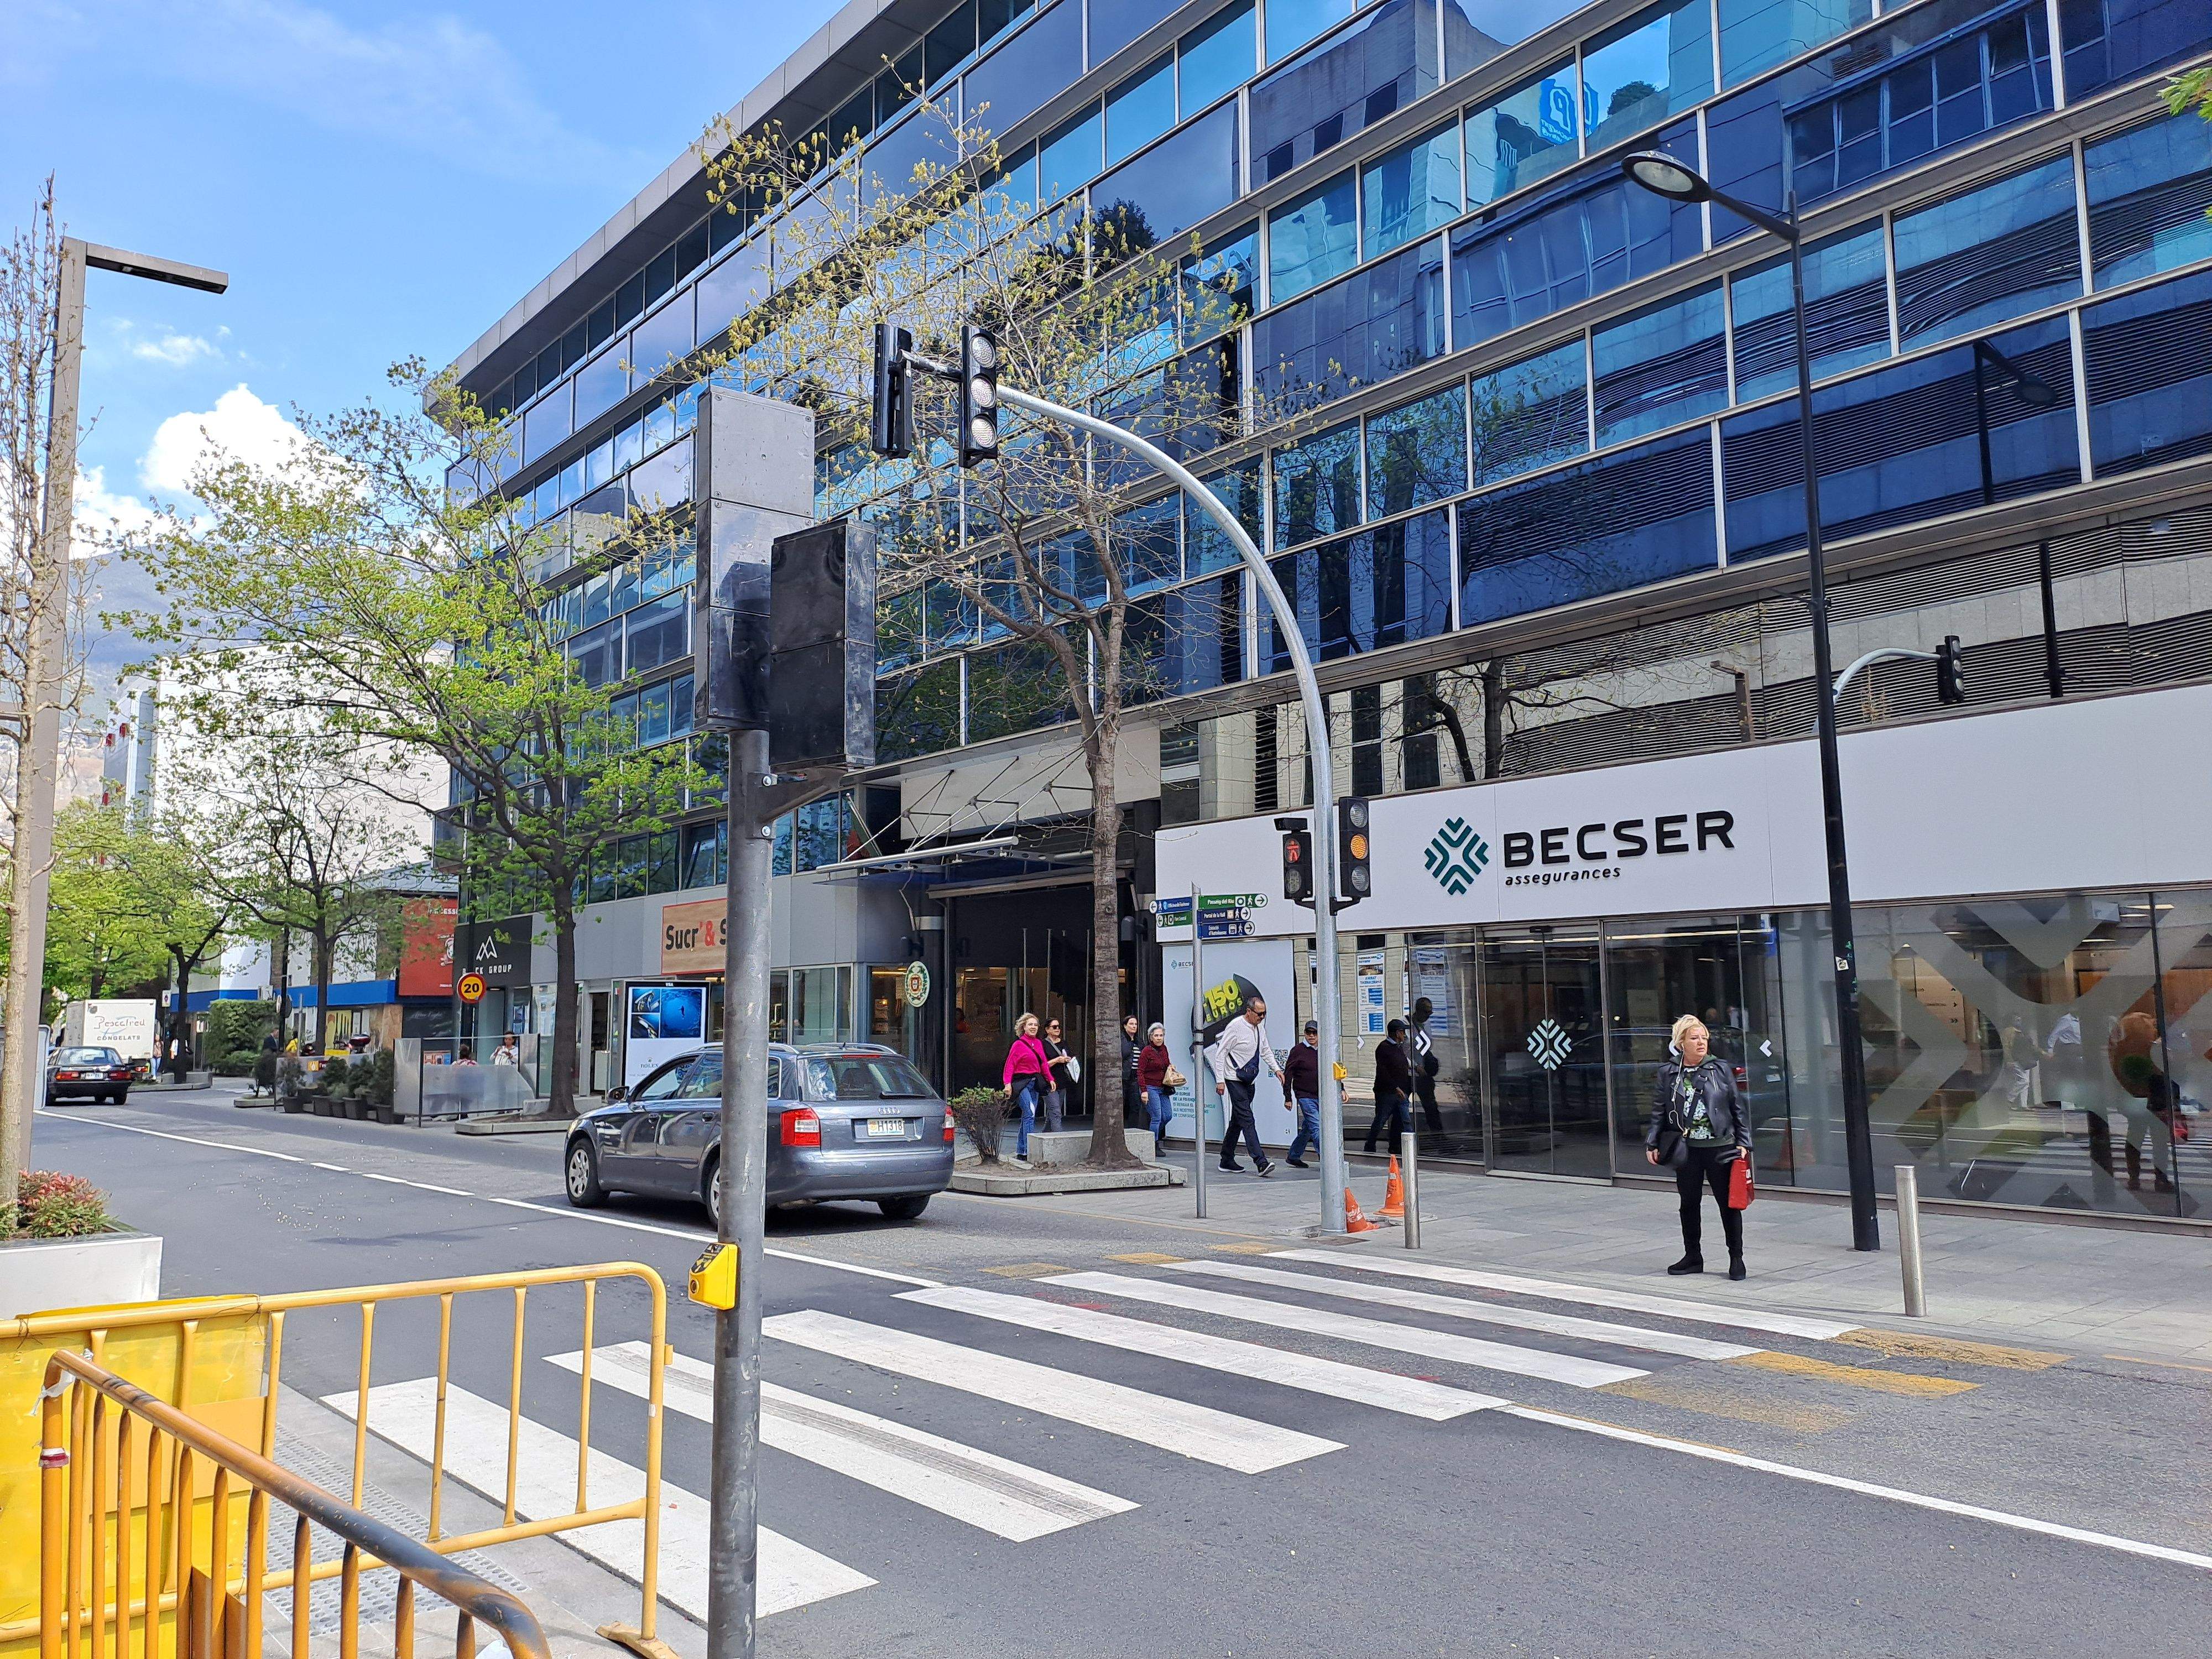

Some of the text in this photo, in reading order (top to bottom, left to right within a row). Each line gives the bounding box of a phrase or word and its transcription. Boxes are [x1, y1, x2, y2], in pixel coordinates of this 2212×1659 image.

[1503, 810, 1735, 868] BECSER
[1505, 865, 1622, 886] assegurances
[488, 964, 512, 974] GROUP
[463, 983, 479, 993] 20
[1206, 997, 1243, 1023] EUROS
[877, 1120, 902, 1132] H1318
